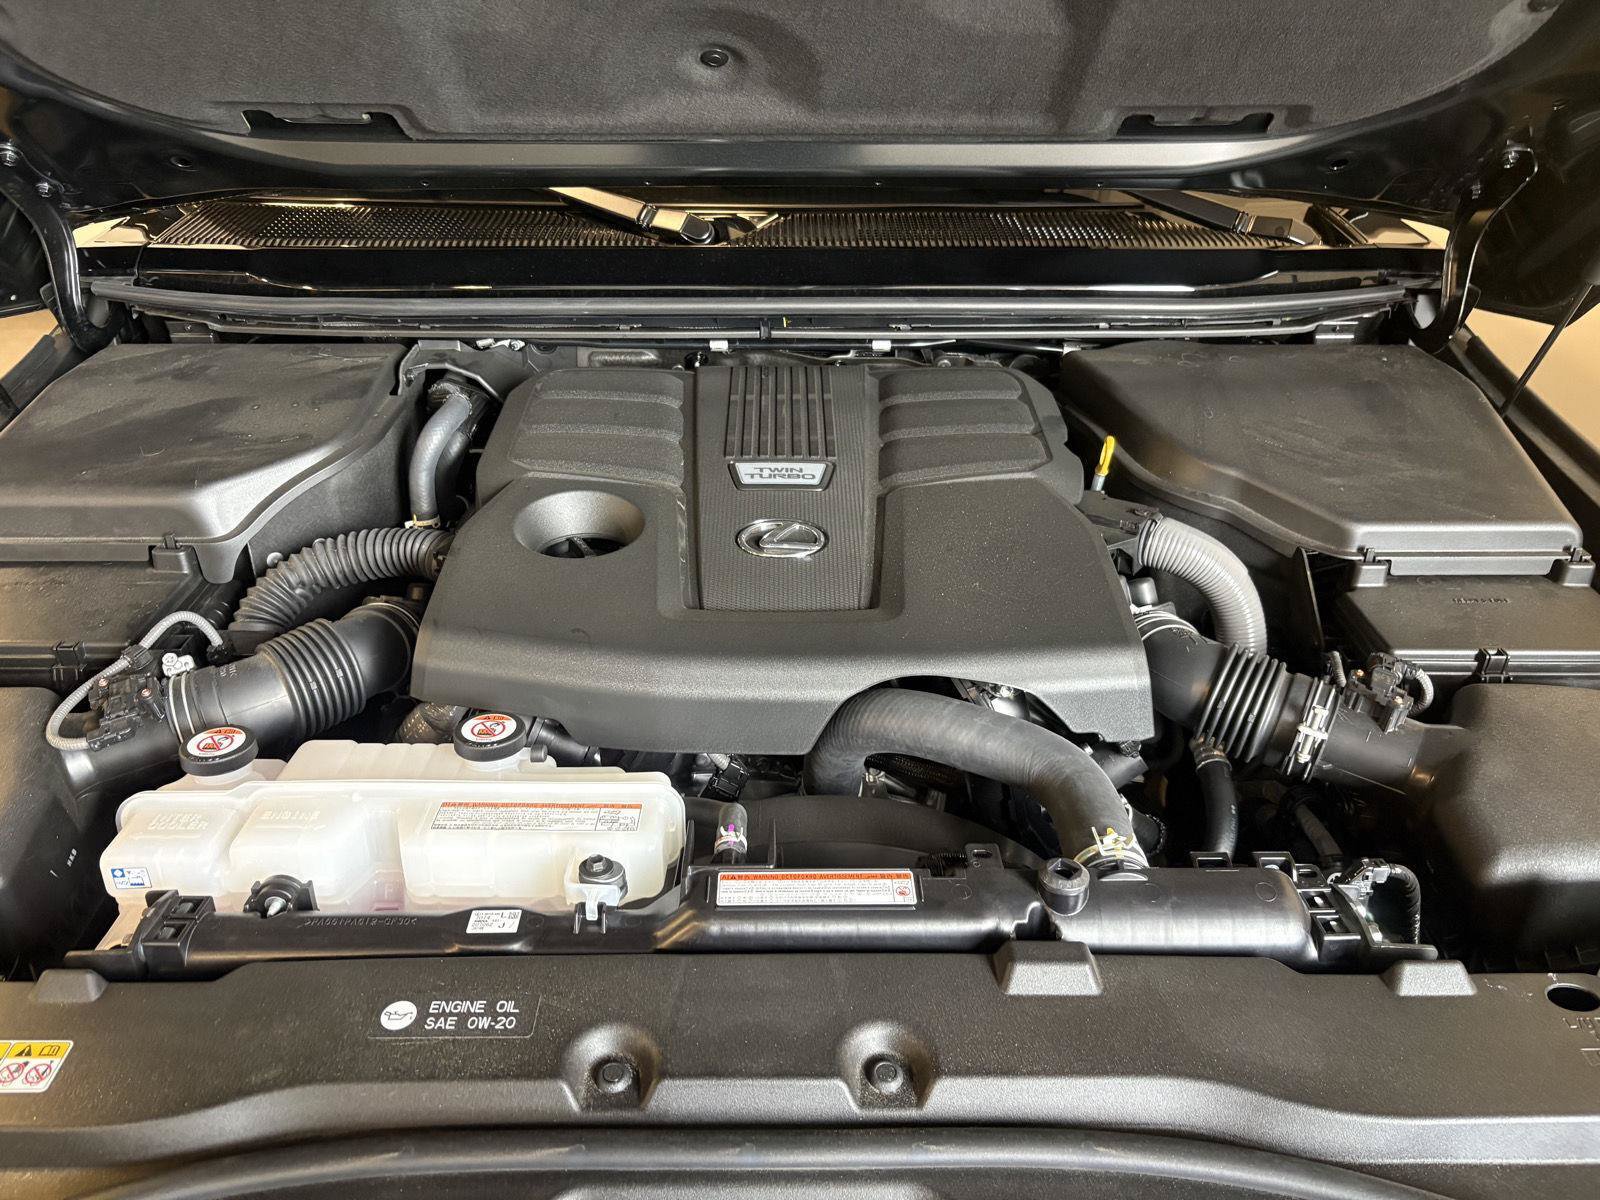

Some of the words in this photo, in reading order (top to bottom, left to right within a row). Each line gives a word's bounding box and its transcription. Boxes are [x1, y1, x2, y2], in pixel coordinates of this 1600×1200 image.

[429, 1001, 486, 1013] ENGINE
[496, 1000, 519, 1013] OIL
[424, 1016, 458, 1030] SAE
[467, 1016, 516, 1029] 0W-20
